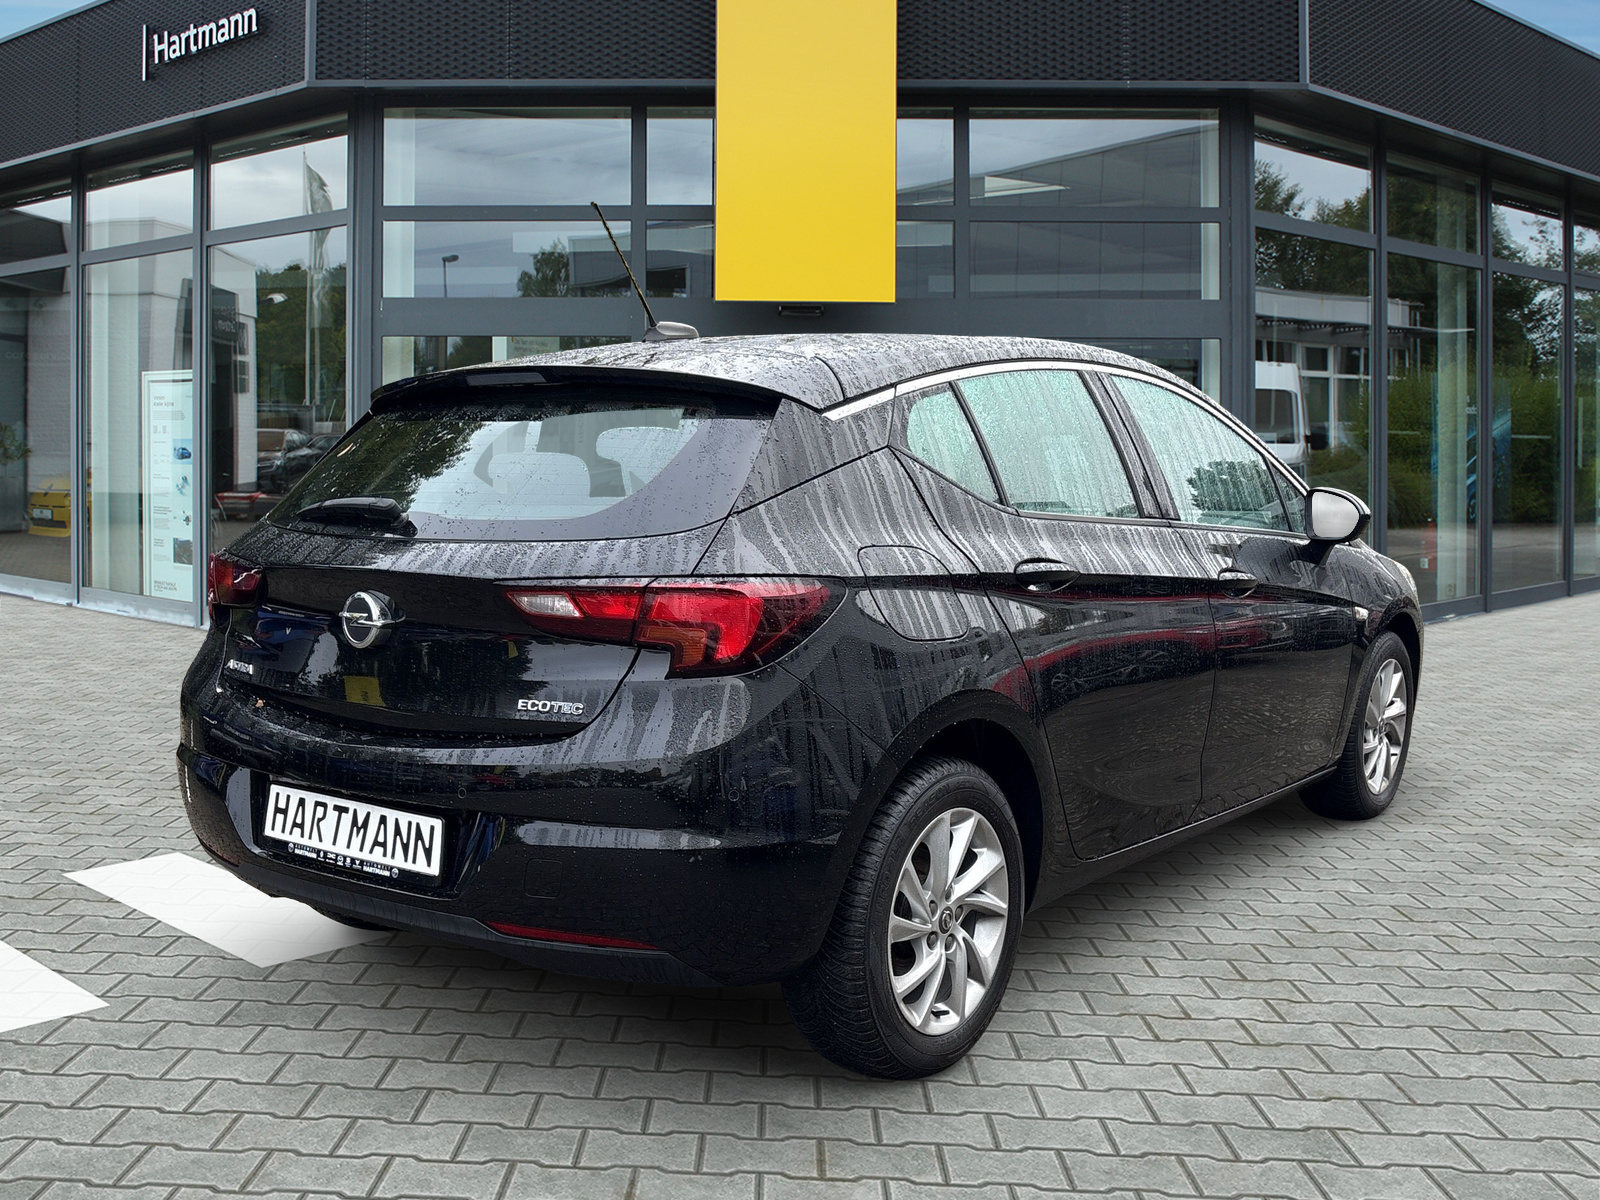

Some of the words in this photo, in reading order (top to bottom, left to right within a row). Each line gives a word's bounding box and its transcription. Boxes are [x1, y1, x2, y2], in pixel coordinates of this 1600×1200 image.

[153, 8, 258, 65] Hartmann
[517, 699, 584, 715] ECOTEC
[271, 791, 436, 868] HARTMANN
